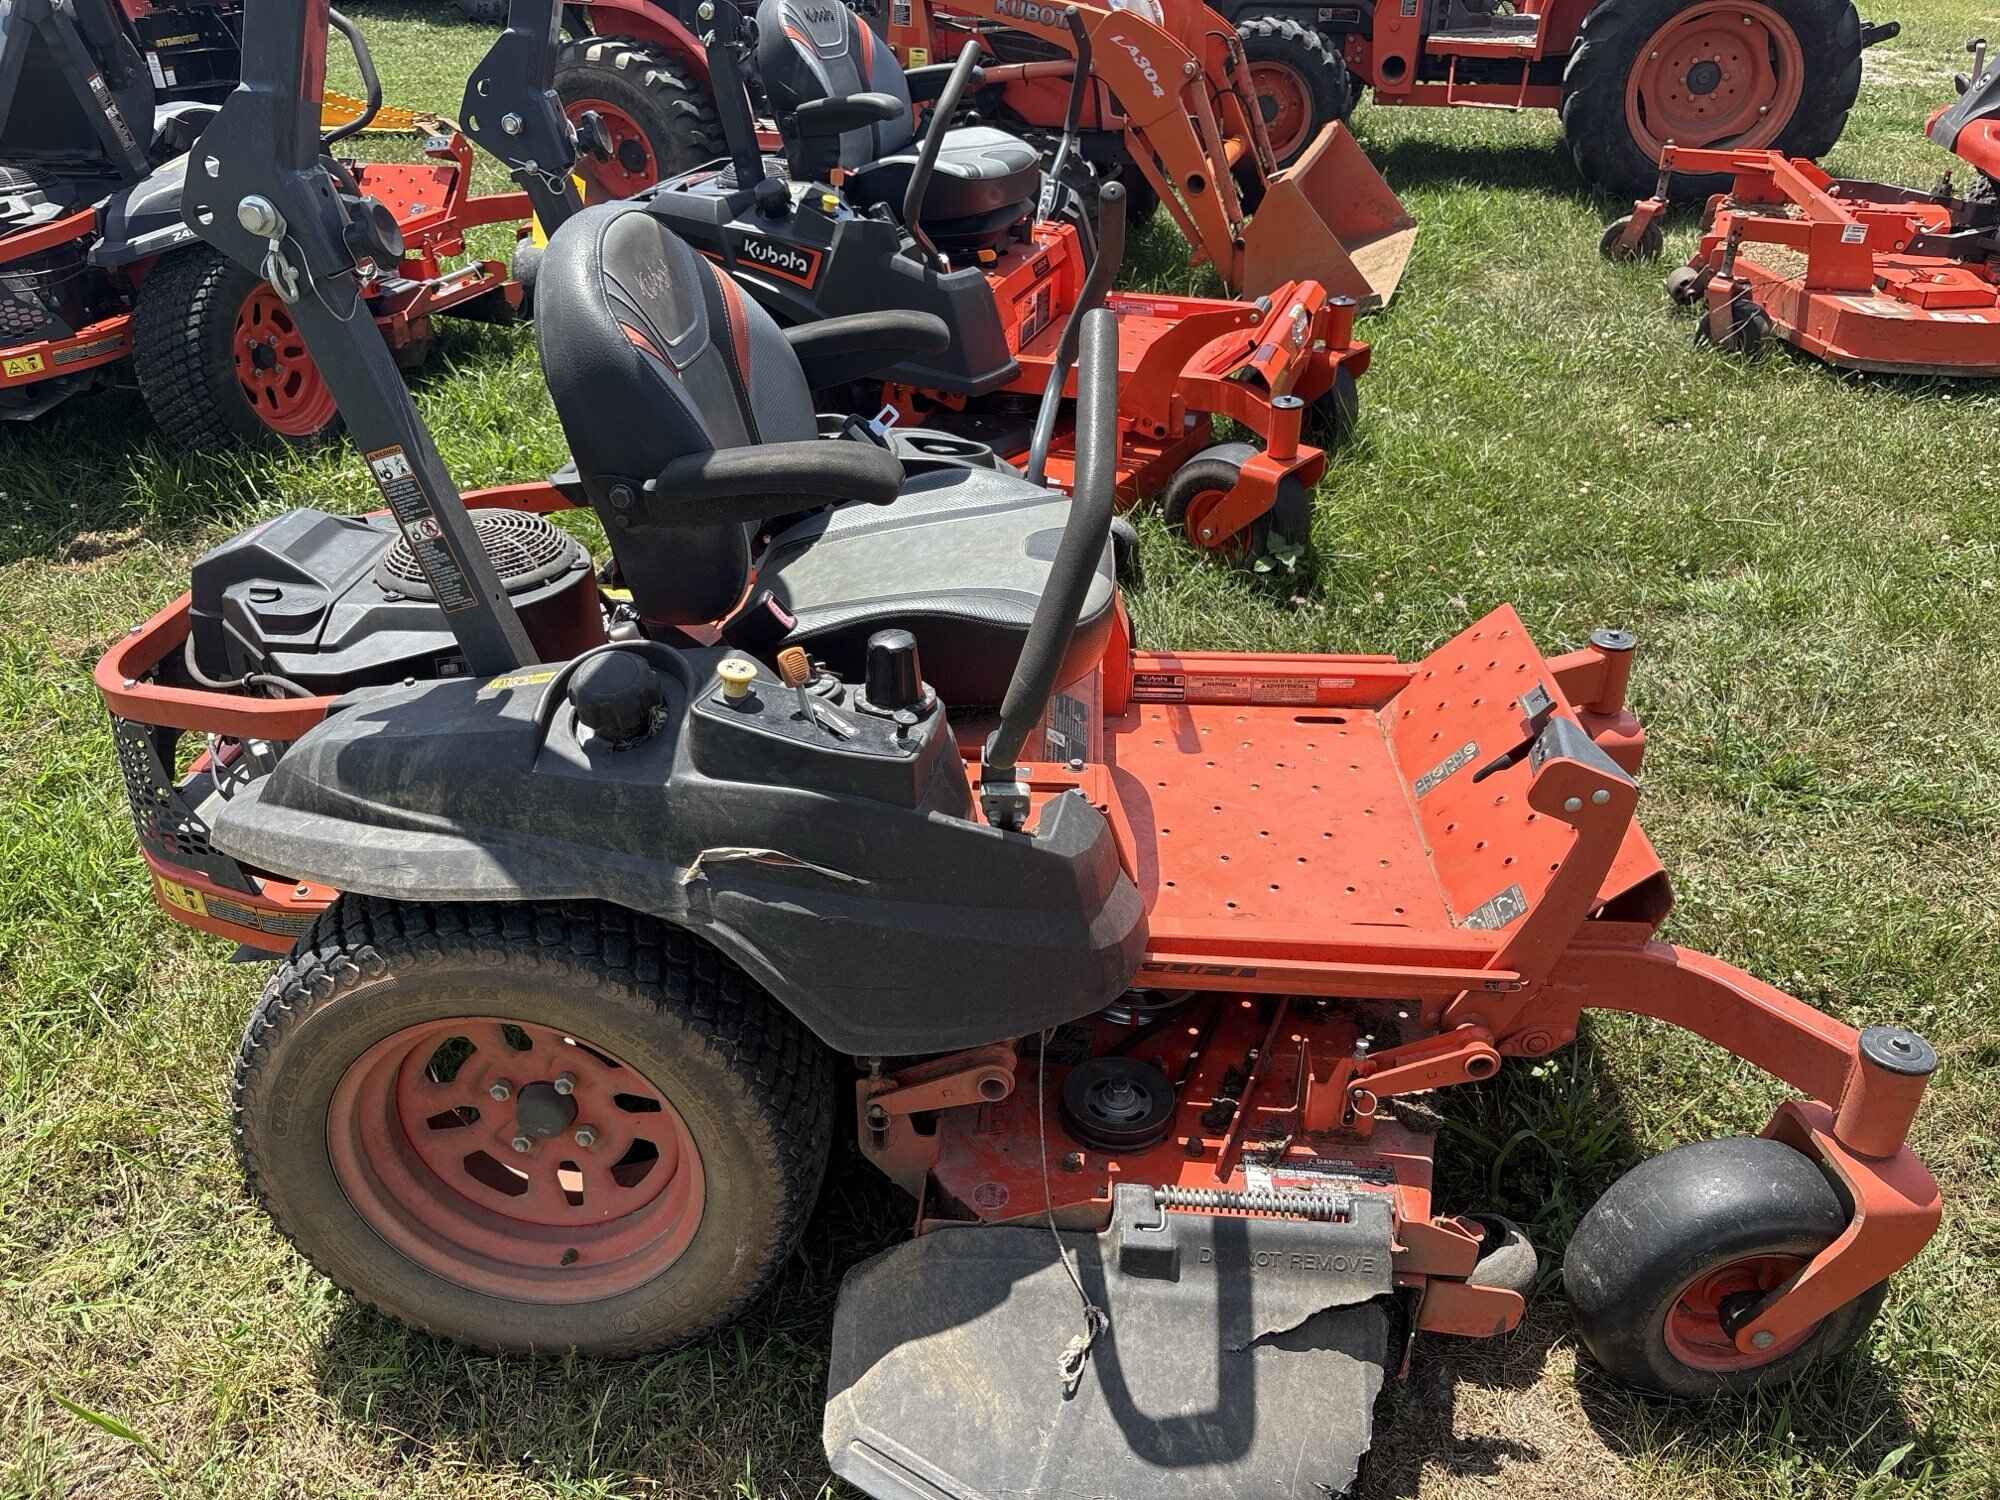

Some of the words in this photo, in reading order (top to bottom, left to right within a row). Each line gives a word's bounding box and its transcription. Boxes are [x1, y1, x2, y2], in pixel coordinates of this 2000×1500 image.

[993, 0, 1072, 30] KUBOT
[1109, 35, 1166, 97] LA304
[744, 239, 808, 273] Kubota
[1240, 1250, 1283, 1268] NOT
[1290, 1252, 1377, 1274] REMOVE
